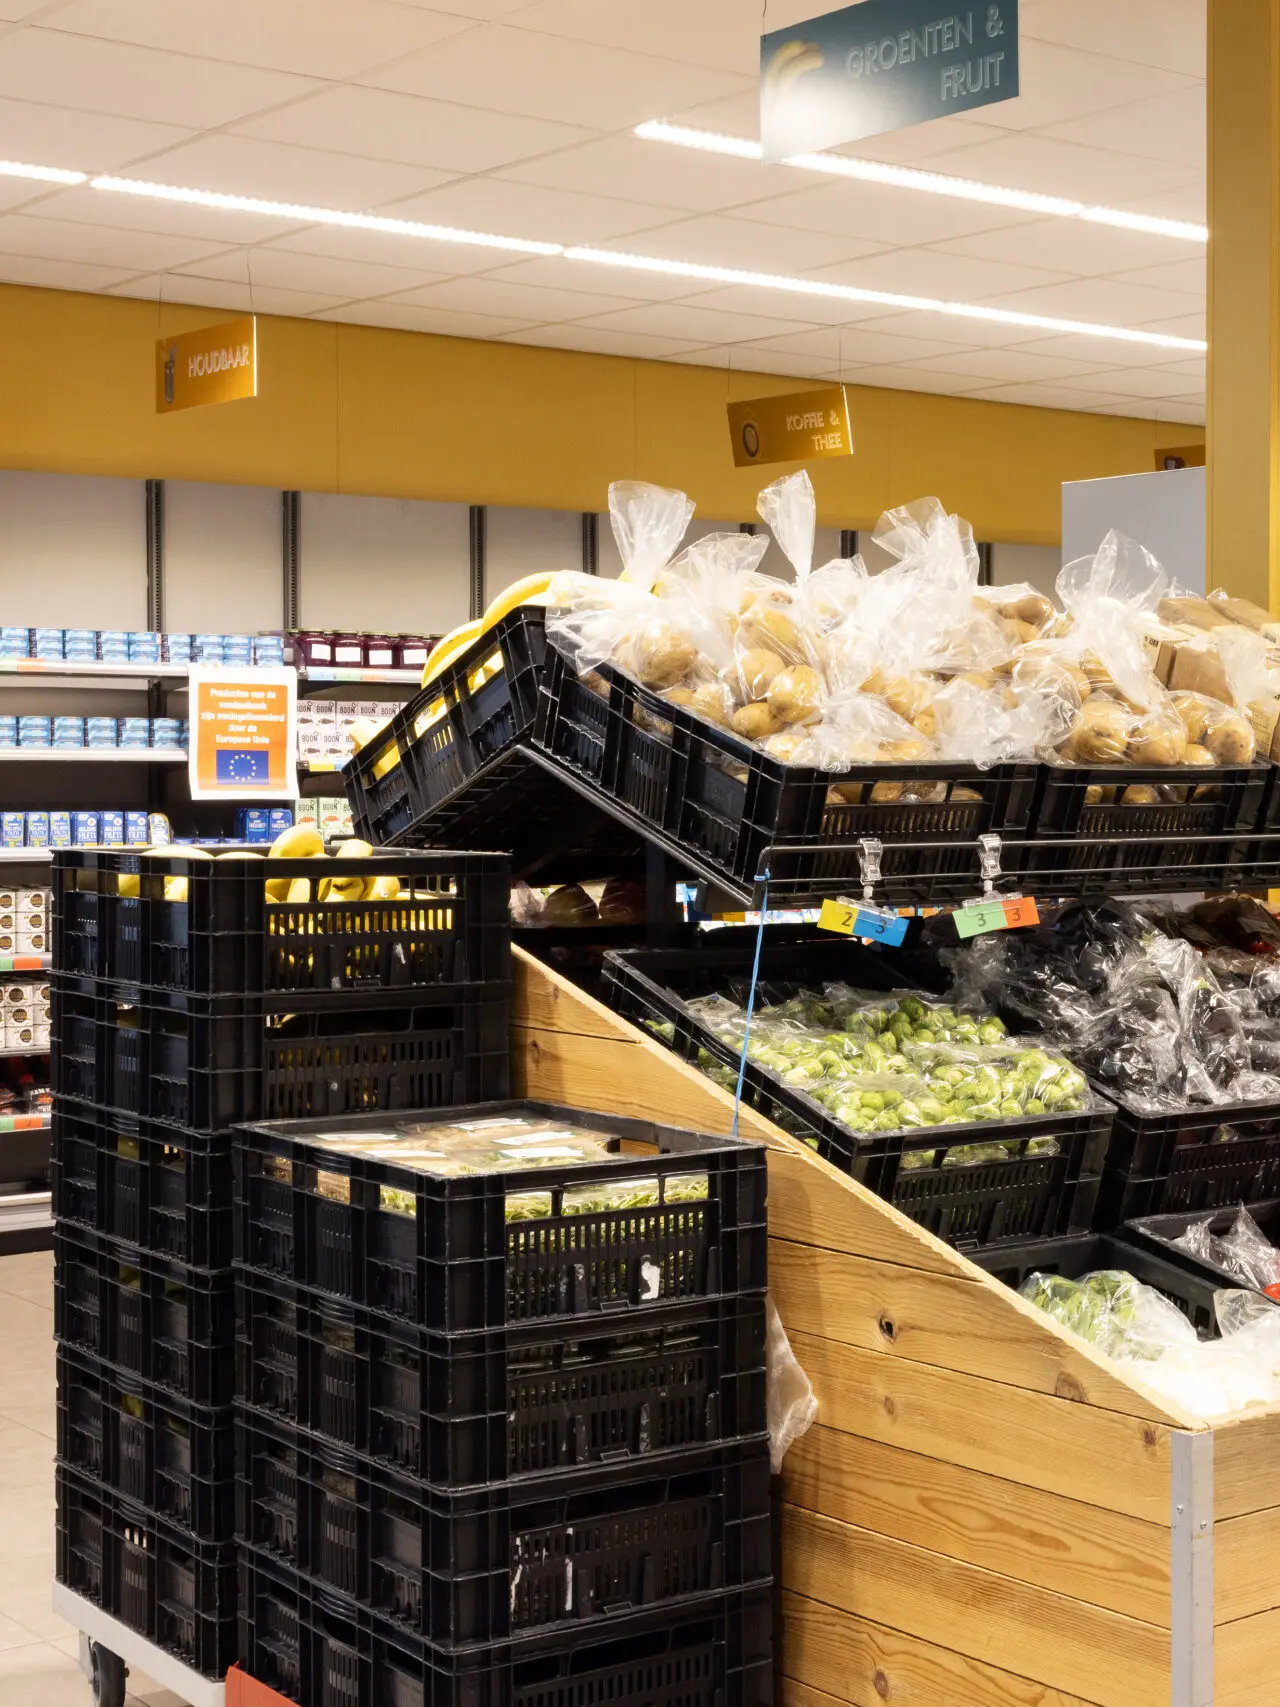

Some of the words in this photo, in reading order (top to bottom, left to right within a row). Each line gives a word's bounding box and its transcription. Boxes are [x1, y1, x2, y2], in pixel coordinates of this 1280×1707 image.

[845, 11, 973, 79] GROENTEN
[986, 4, 1006, 38] &
[940, 51, 1004, 100] FRUIT
[188, 343, 249, 378] HOUDBAAR
[785, 411, 824, 431] KOFFIE
[830, 410, 840, 426] &
[811, 432, 842, 451] THEE
[316, 705, 333, 713] BOON
[340, 706, 356, 714] BOON
[361, 706, 376, 714] BOON
[381, 707, 396, 715] BOON
[302, 734, 318, 742] BOON
[324, 735, 340, 743] BOON
[299, 803, 314, 812] BOON
[323, 803, 338, 811] BOON
[977, 913, 987, 928] 3
[1012, 908, 1022, 922] 3
[841, 911, 853, 928] 2
[874, 920, 886, 935] 3
